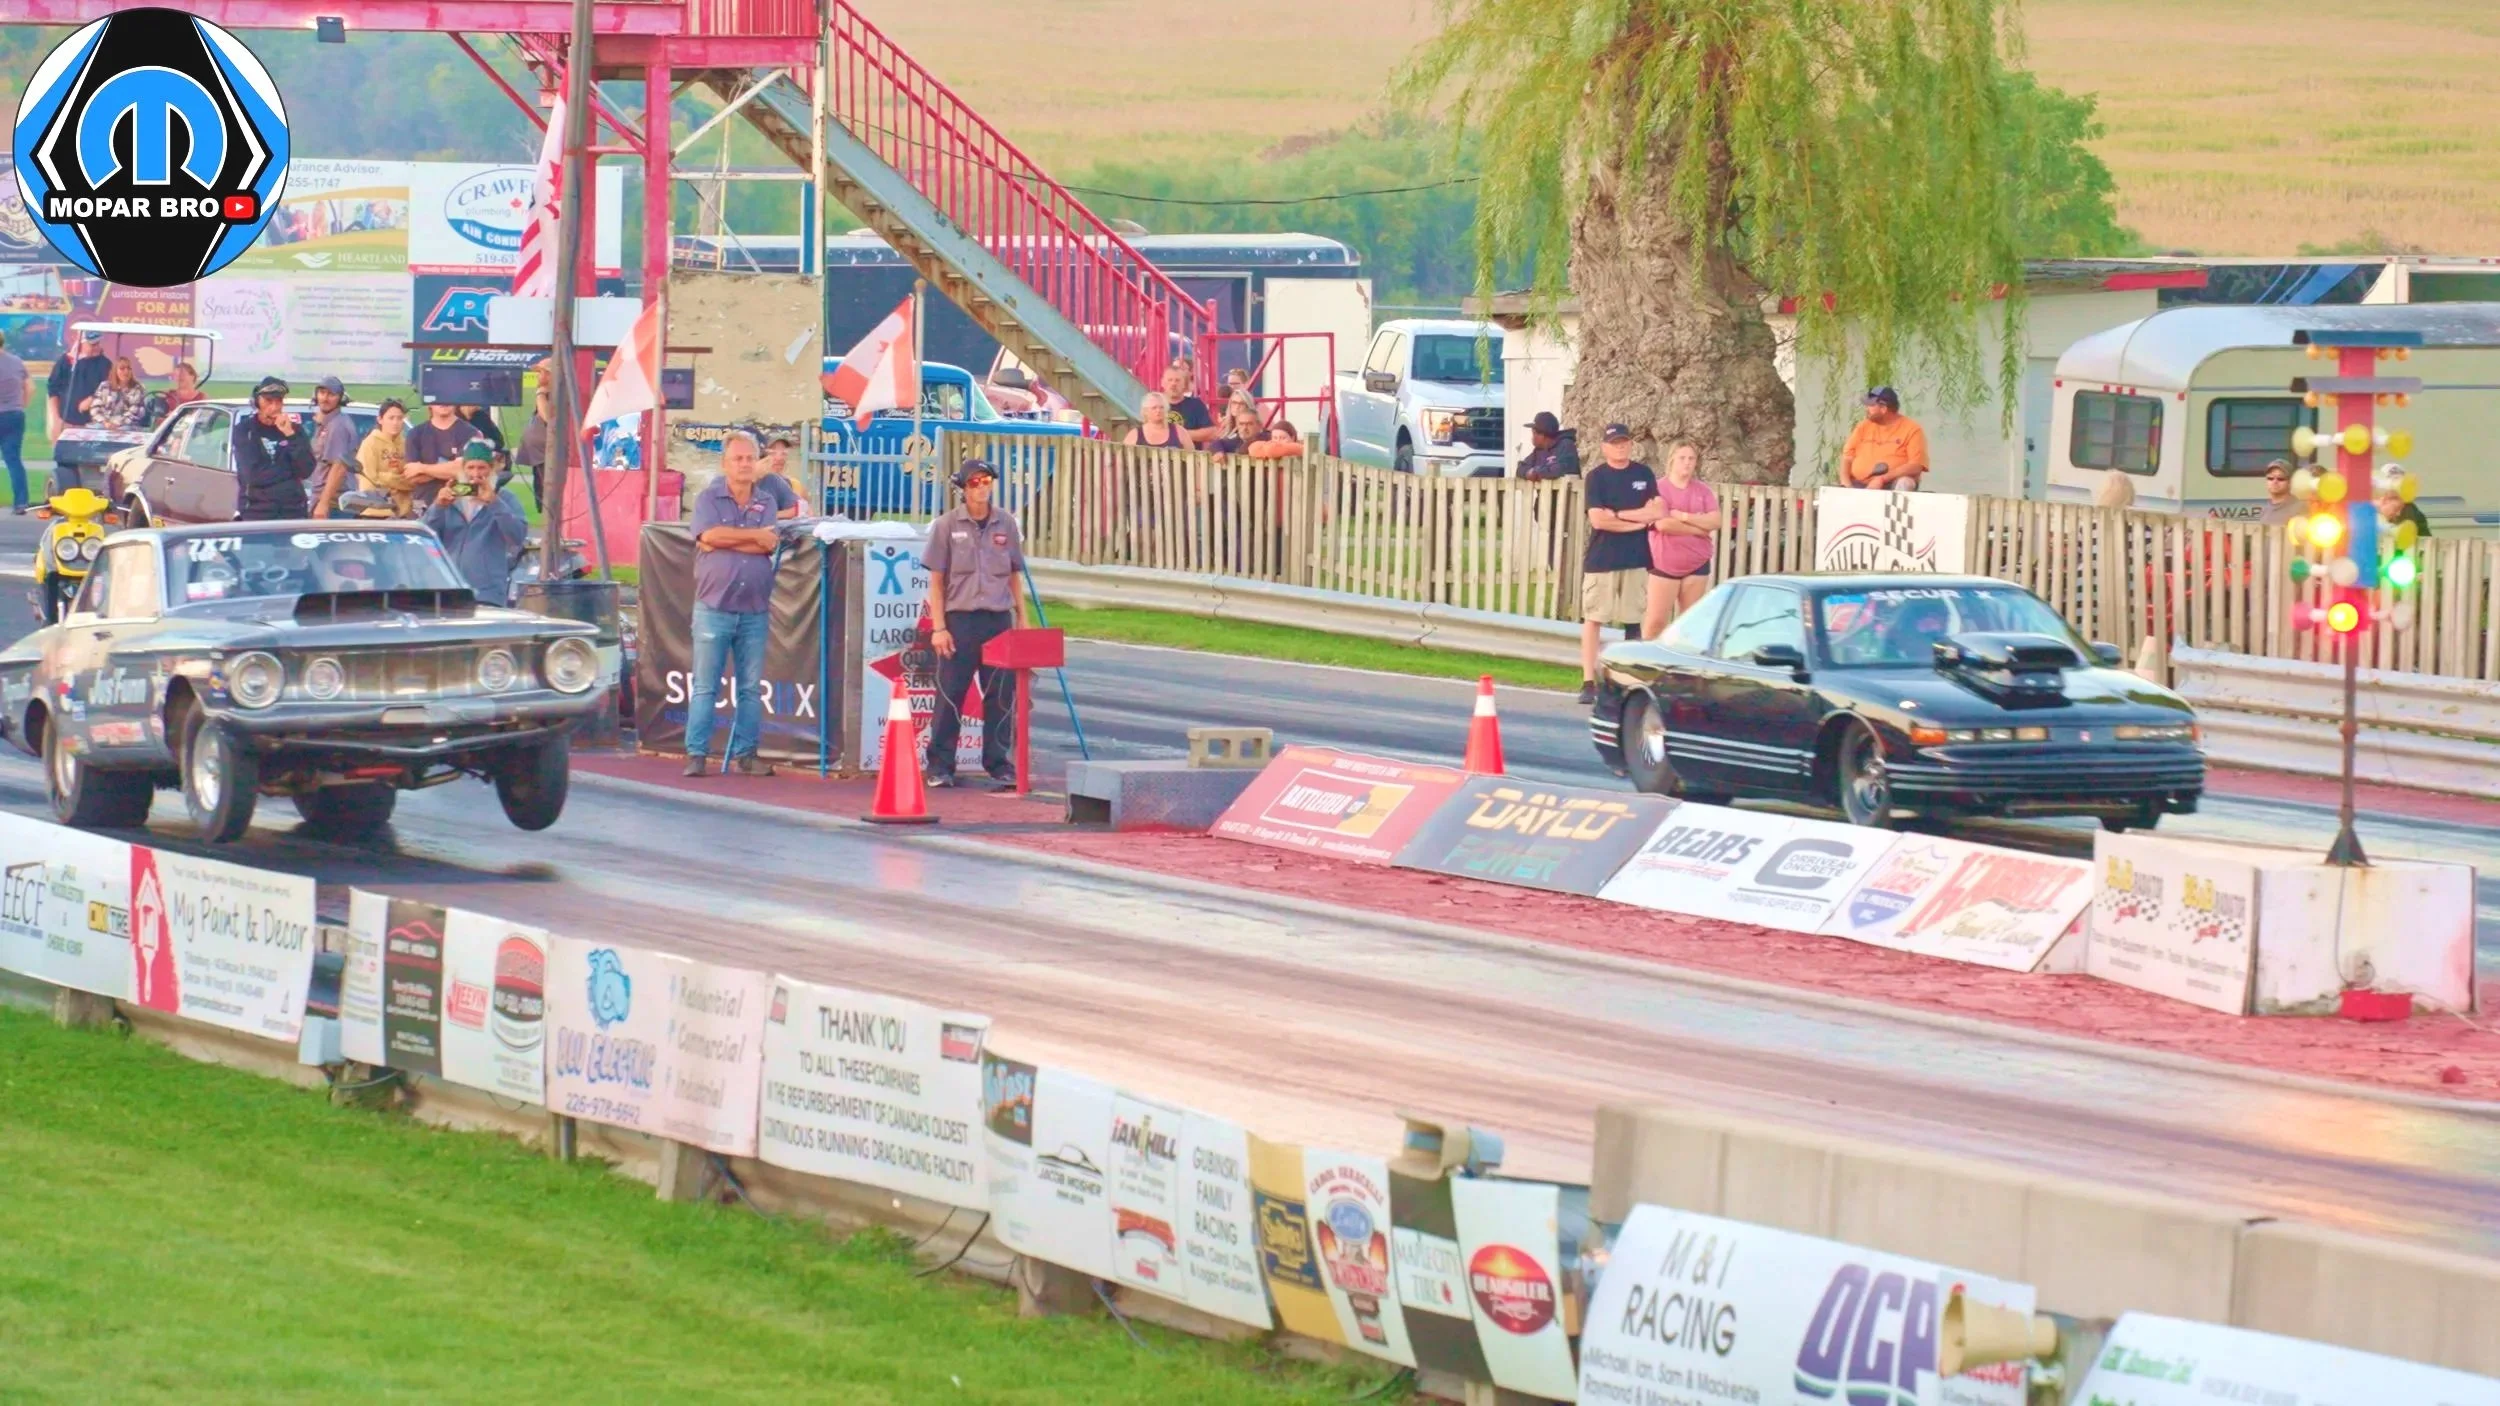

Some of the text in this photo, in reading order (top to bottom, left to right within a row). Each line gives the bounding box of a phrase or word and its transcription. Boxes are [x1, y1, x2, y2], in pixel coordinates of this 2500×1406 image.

[462, 222, 481, 241] AIR
[337, 252, 407, 265] HEARTLAND
[111, 289, 190, 300] wristband instore
[136, 301, 190, 314] FOR AN
[187, 536, 243, 553] 7X71
[173, 891, 195, 944] My
[200, 895, 240, 939] Paint
[263, 907, 308, 953] Decor
[818, 1006, 907, 1054] THANK YOU
[799, 1051, 813, 1074] TO
[815, 1055, 836, 1079] ALL
[787, 1085, 873, 1121] REFURBISHMENT
[873, 1103, 887, 1126] OF
[887, 1105, 931, 1137] CANADA'S
[932, 1116, 969, 1147] OLDEST
[764, 1115, 975, 1186] CONTINUOUS RUNNING DRAG RACING FACILITY
[1196, 1179, 1234, 1213] FAMILY
[1194, 1210, 1239, 1247] RACING
[1691, 1236, 1718, 1284] &
[1620, 1284, 1738, 1358] RACING
